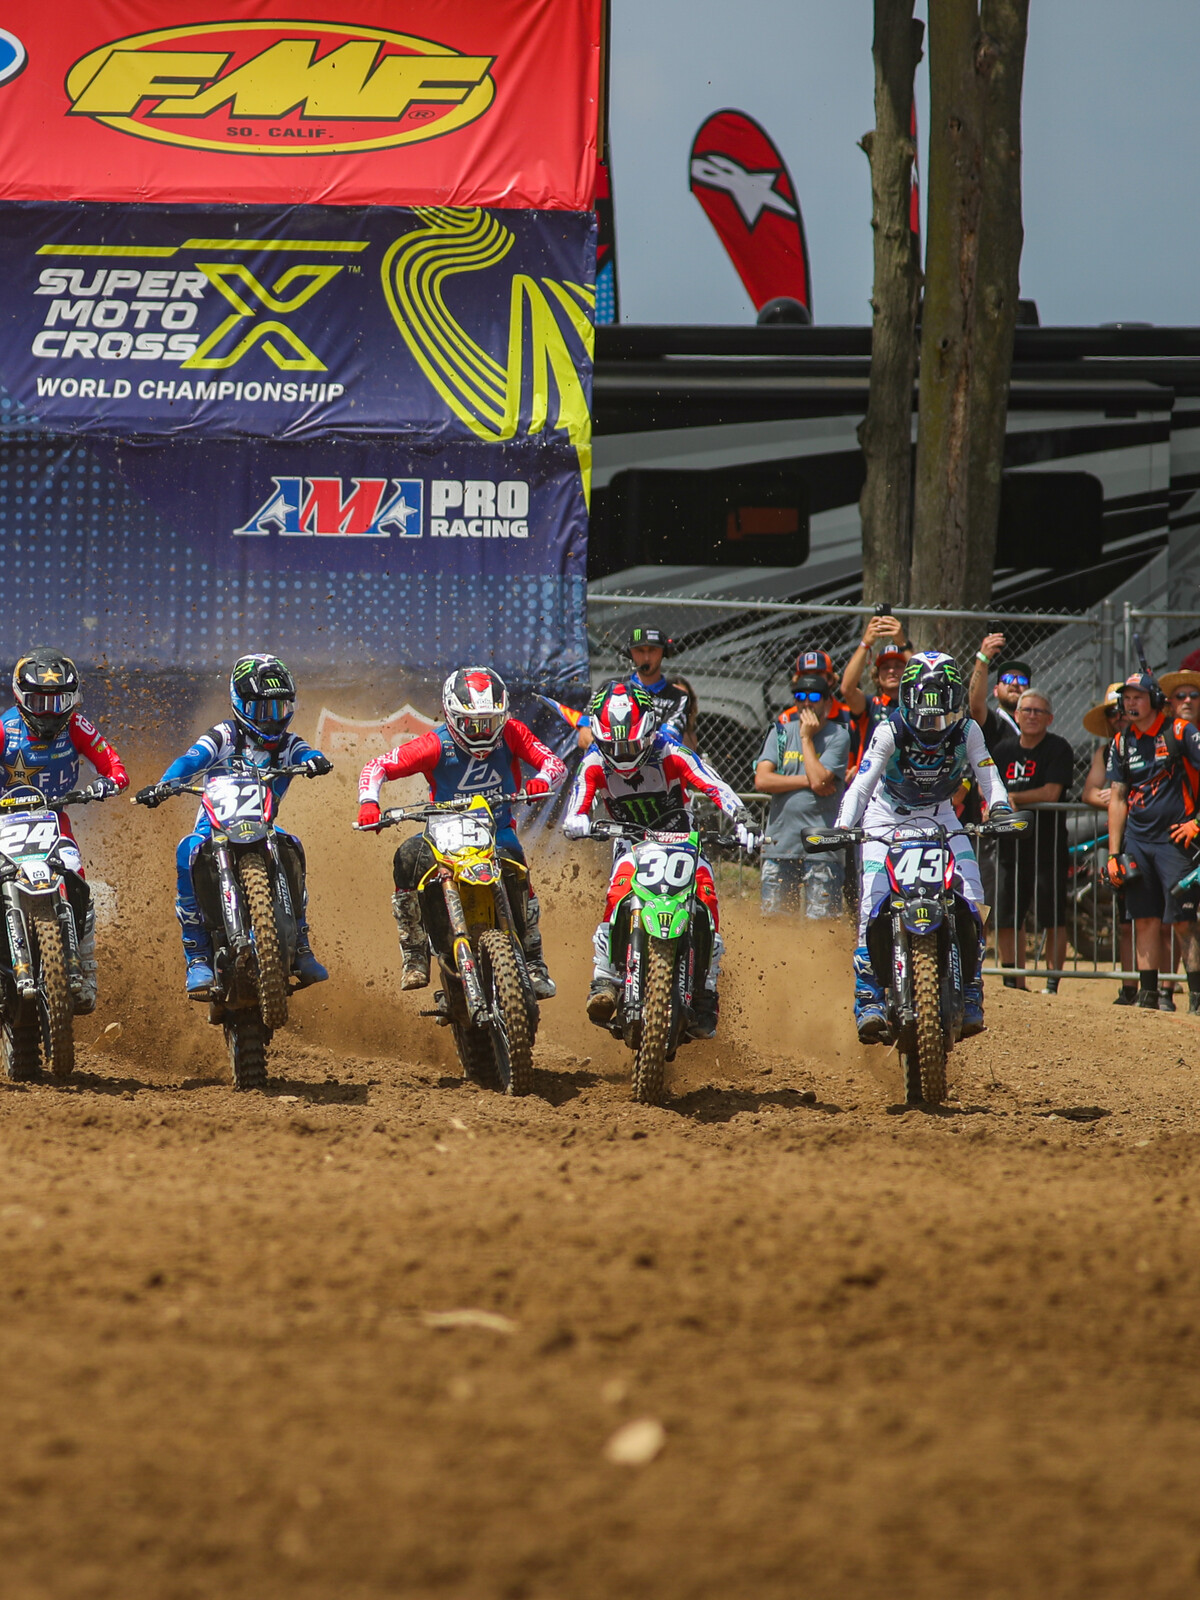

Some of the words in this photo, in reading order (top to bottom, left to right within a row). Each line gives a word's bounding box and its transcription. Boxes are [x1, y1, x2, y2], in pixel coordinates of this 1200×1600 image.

[66, 40, 498, 121] FMF
[226, 126, 261, 139] SO.
[267, 126, 335, 140] CALIF.
[33, 267, 209, 298] SUPER
[43, 299, 199, 330] MOTO
[31, 331, 201, 361] CROSS
[35, 377, 132, 399] WORLD
[138, 379, 345, 403] CHAMPIONSHIP
[234, 476, 424, 538] AMA
[430, 480, 530, 518] PRO
[430, 519, 529, 539] RACING
[212, 784, 266, 821] 32
[636, 850, 695, 887] 30
[894, 848, 949, 886] 43
[278, 872, 292, 915] DUNLOP
[952, 943, 961, 992] DUNLOP
